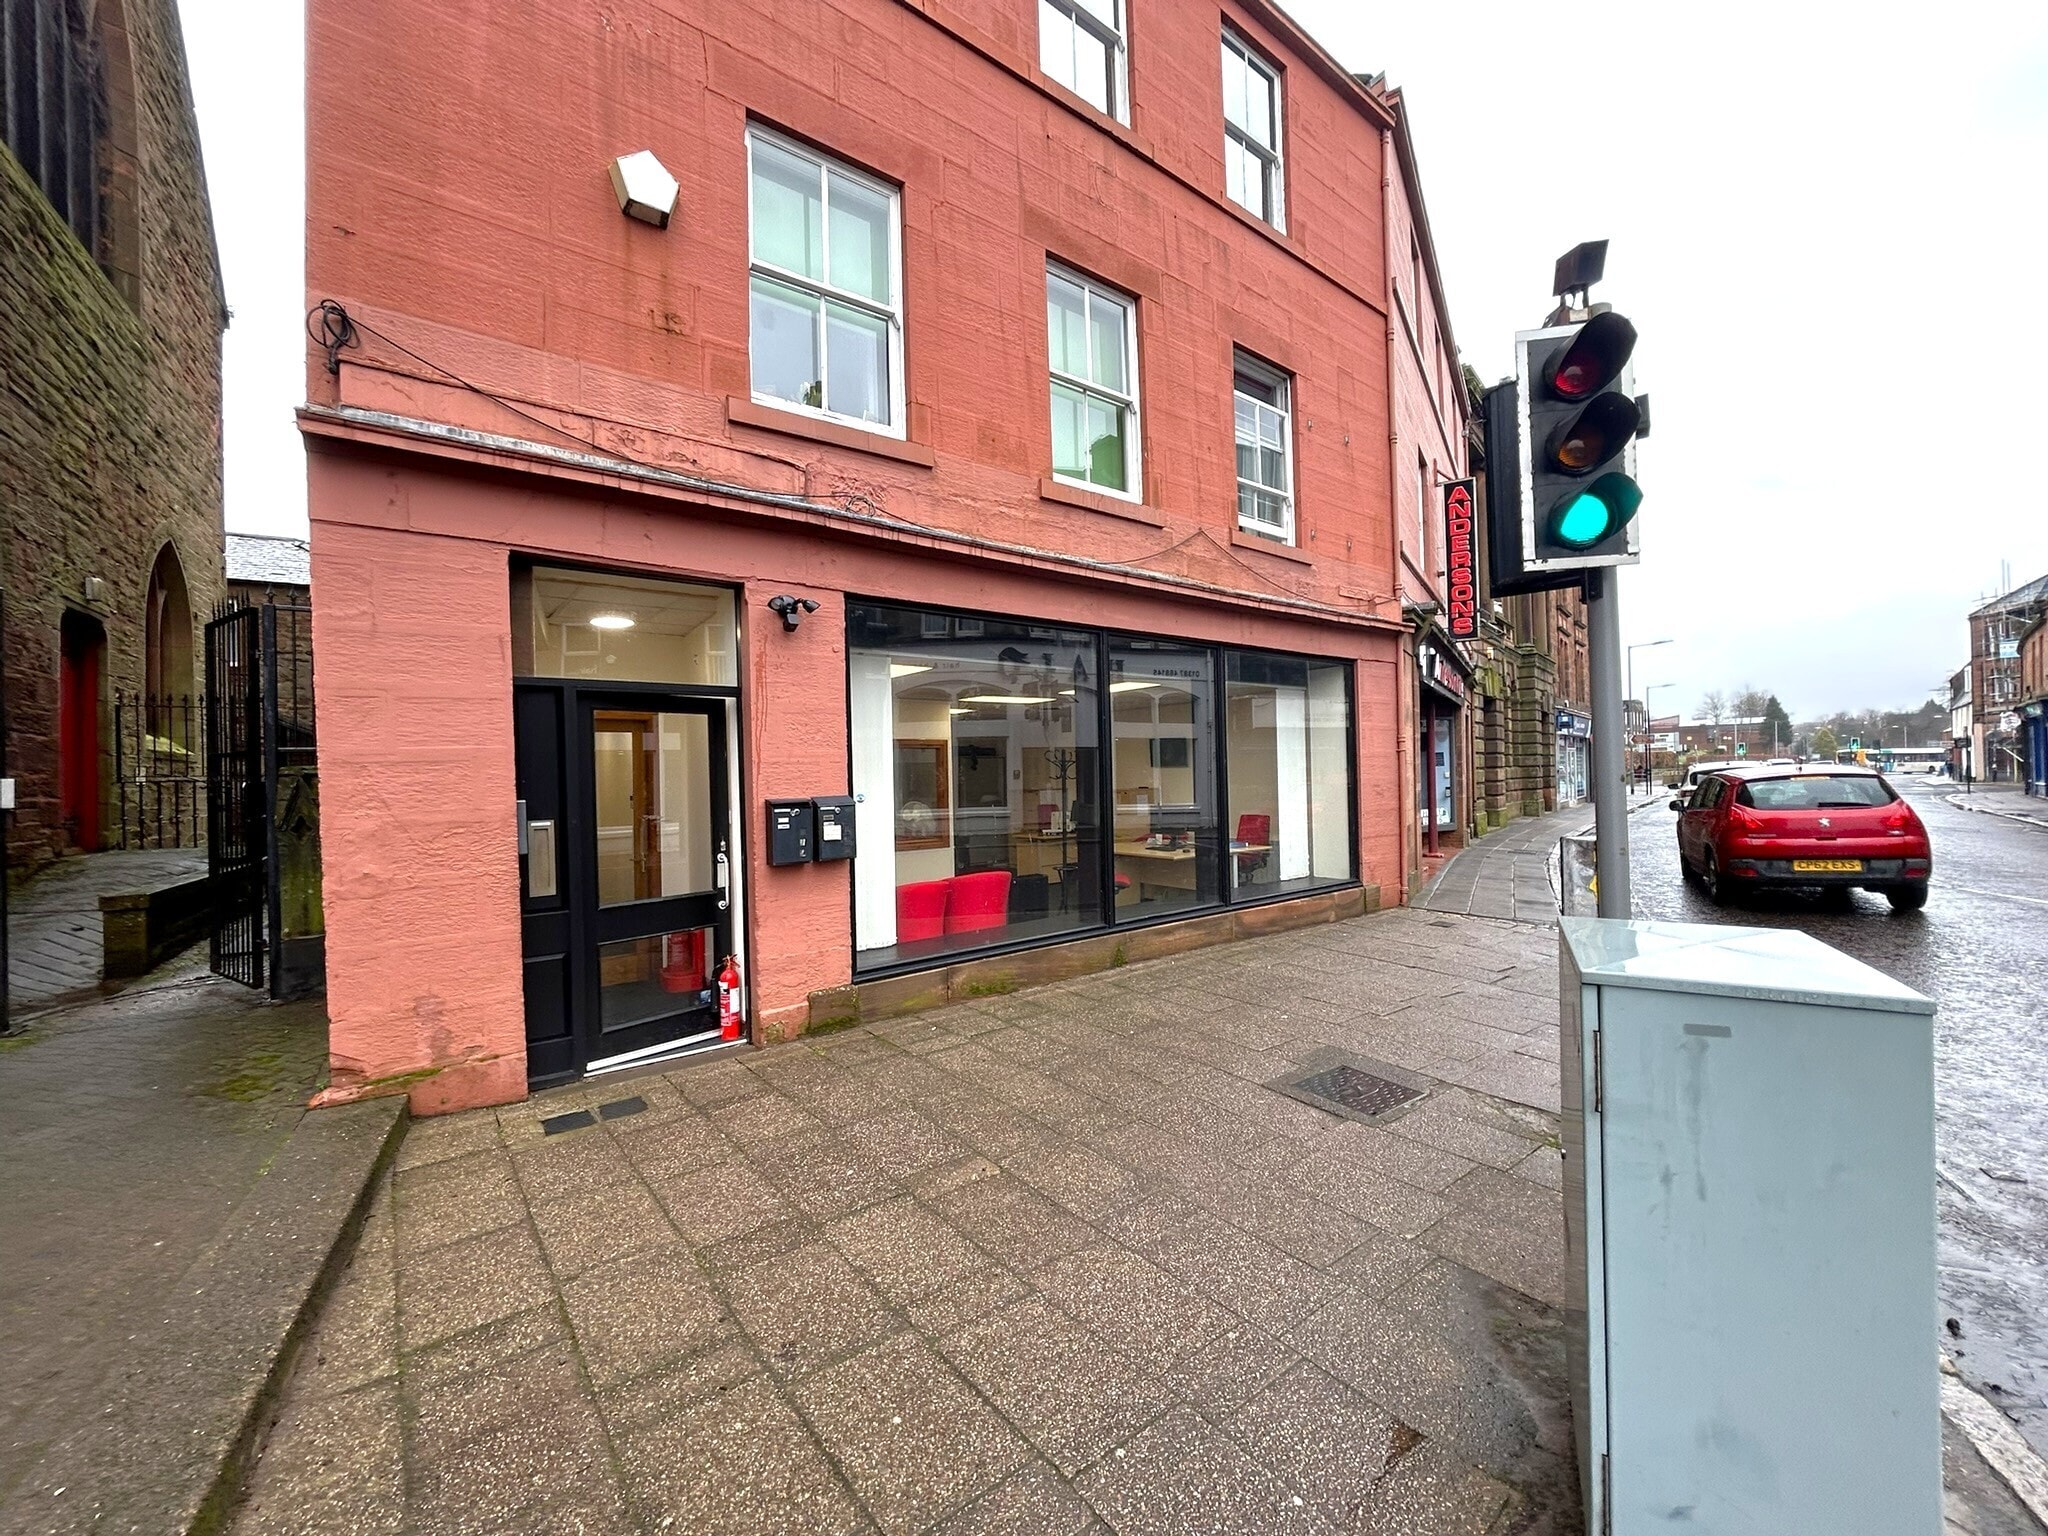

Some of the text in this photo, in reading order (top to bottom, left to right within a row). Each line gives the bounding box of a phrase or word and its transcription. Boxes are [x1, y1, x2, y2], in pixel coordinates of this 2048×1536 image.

[1447, 485, 1474, 635] ANDERSONS
[1798, 860, 1856, 870] CP62 EXS
